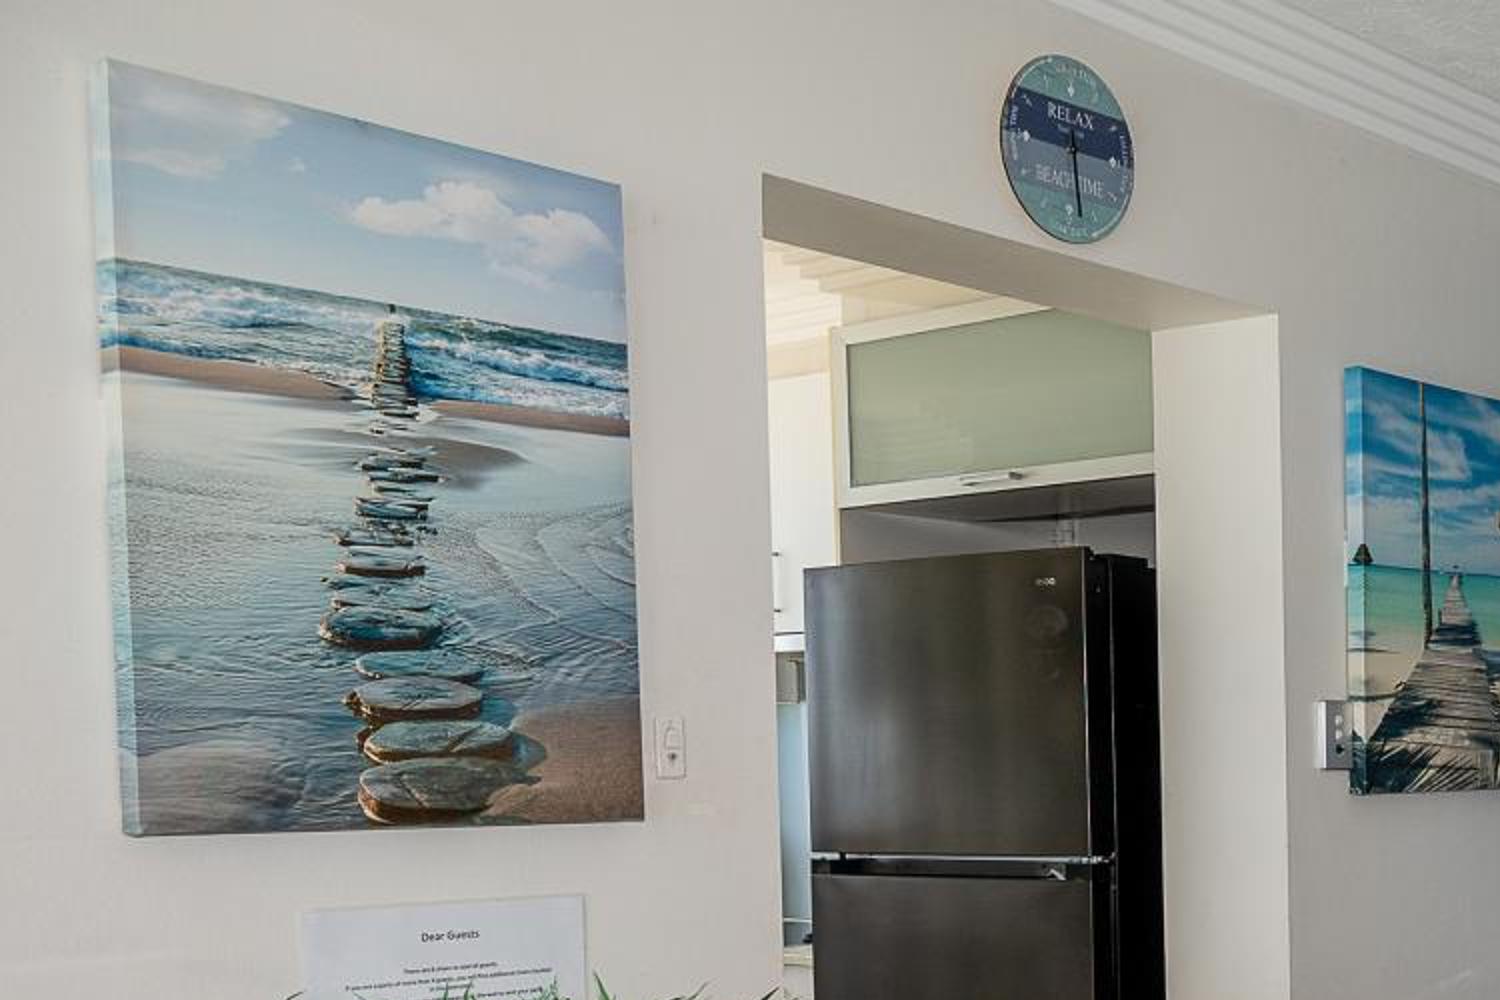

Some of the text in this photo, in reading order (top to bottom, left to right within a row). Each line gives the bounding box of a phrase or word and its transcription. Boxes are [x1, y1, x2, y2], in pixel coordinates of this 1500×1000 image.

[1047, 101, 1094, 129] RELAX
[421, 928, 480, 943] Dear Guests
